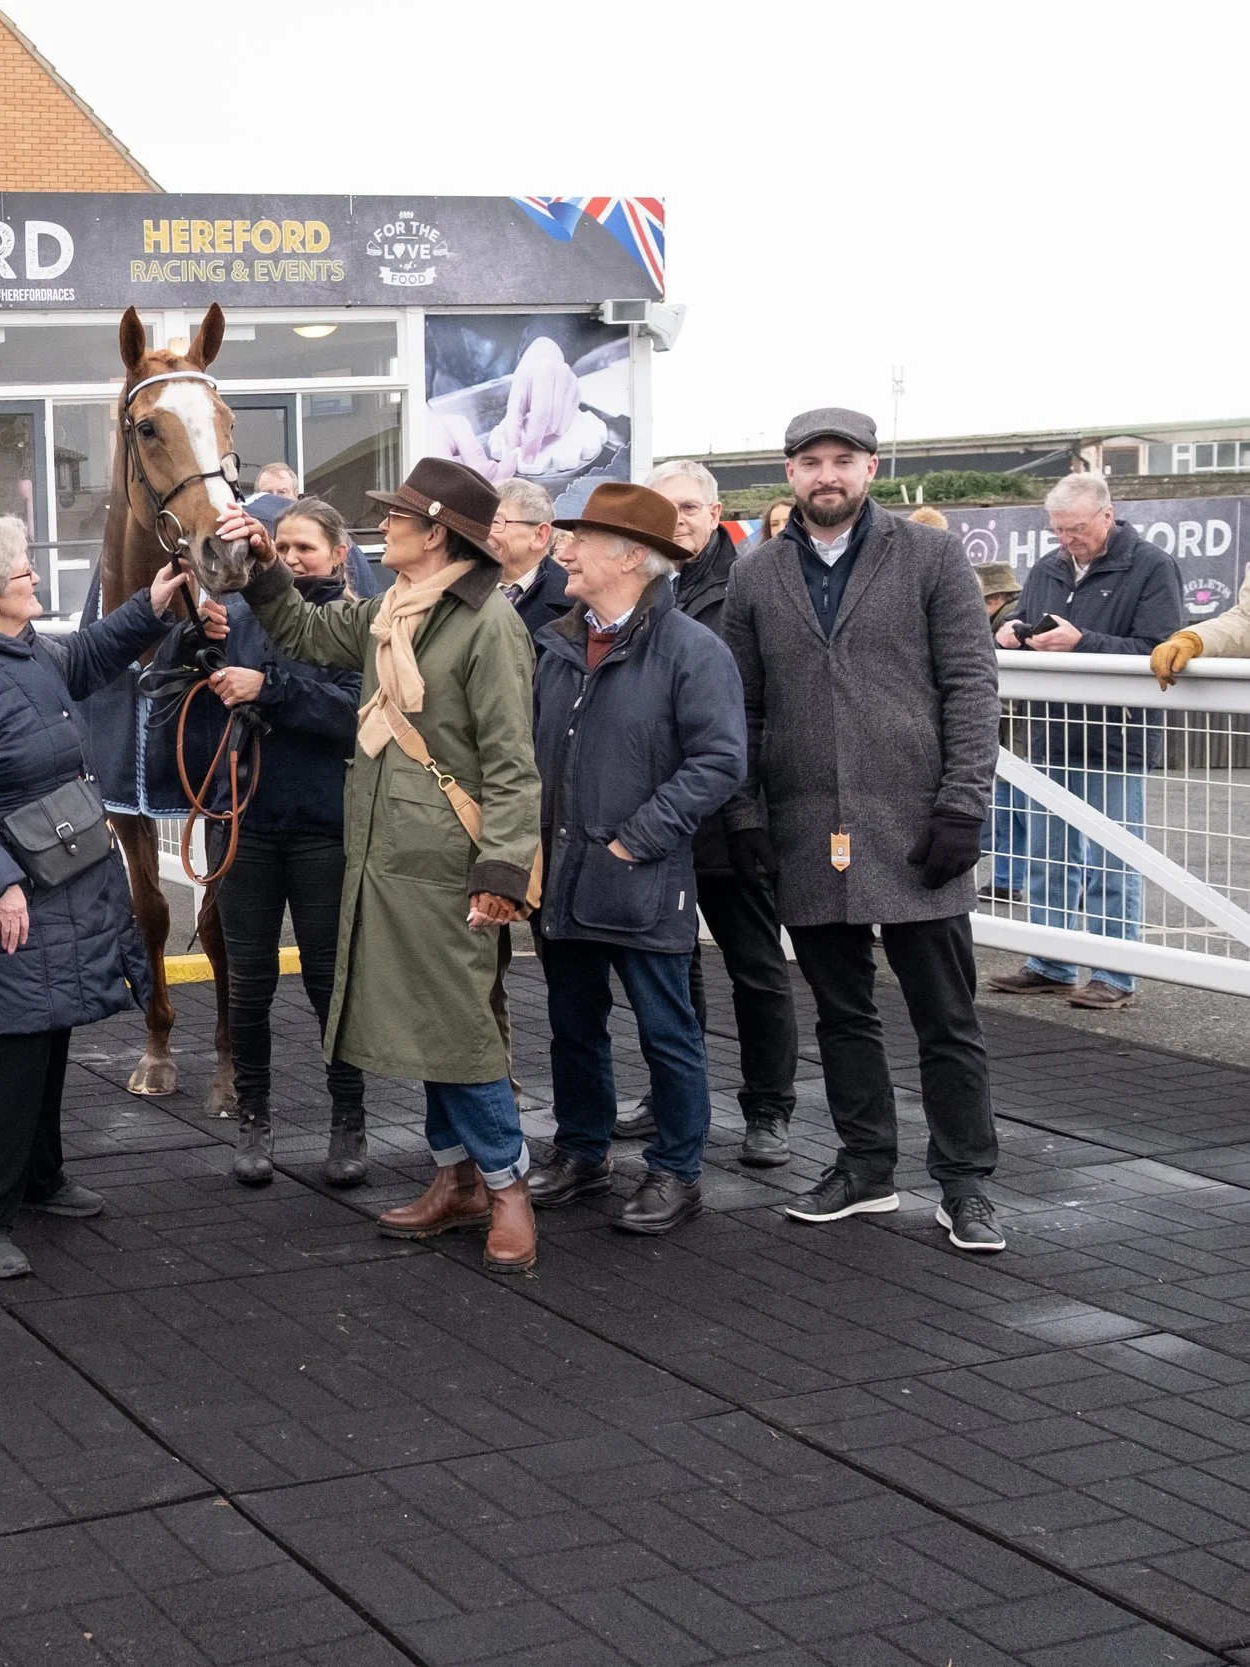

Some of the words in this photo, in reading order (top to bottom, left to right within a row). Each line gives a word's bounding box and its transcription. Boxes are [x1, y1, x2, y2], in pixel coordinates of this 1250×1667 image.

[143, 219, 330, 254] HEREFORD
[373, 221, 406, 243] FOR
[409, 221, 440, 243] THE
[130, 259, 226, 282] RACING
[230, 260, 250, 282] &
[254, 259, 345, 282] EVENTS
[391, 274, 426, 284] FOOD
